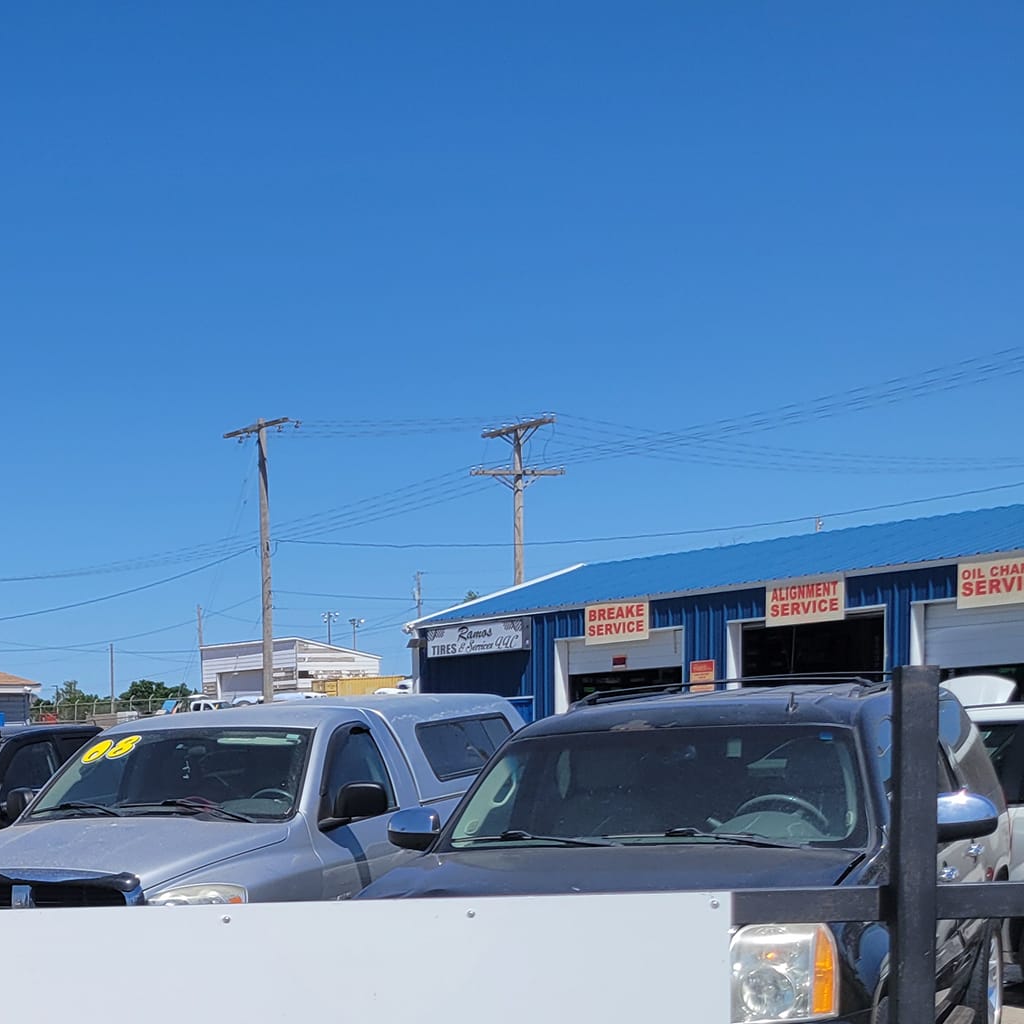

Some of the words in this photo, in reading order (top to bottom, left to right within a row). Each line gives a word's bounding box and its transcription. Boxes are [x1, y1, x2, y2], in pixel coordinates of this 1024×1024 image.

[961, 568, 985, 580] OIL
[771, 580, 838, 602] ALIGNMENT
[588, 604, 645, 622] BREAKE
[770, 598, 839, 618] SERVICE
[457, 625, 493, 641] Ramos
[588, 619, 645, 637] SERVICE
[431, 643, 457, 656] TIRES
